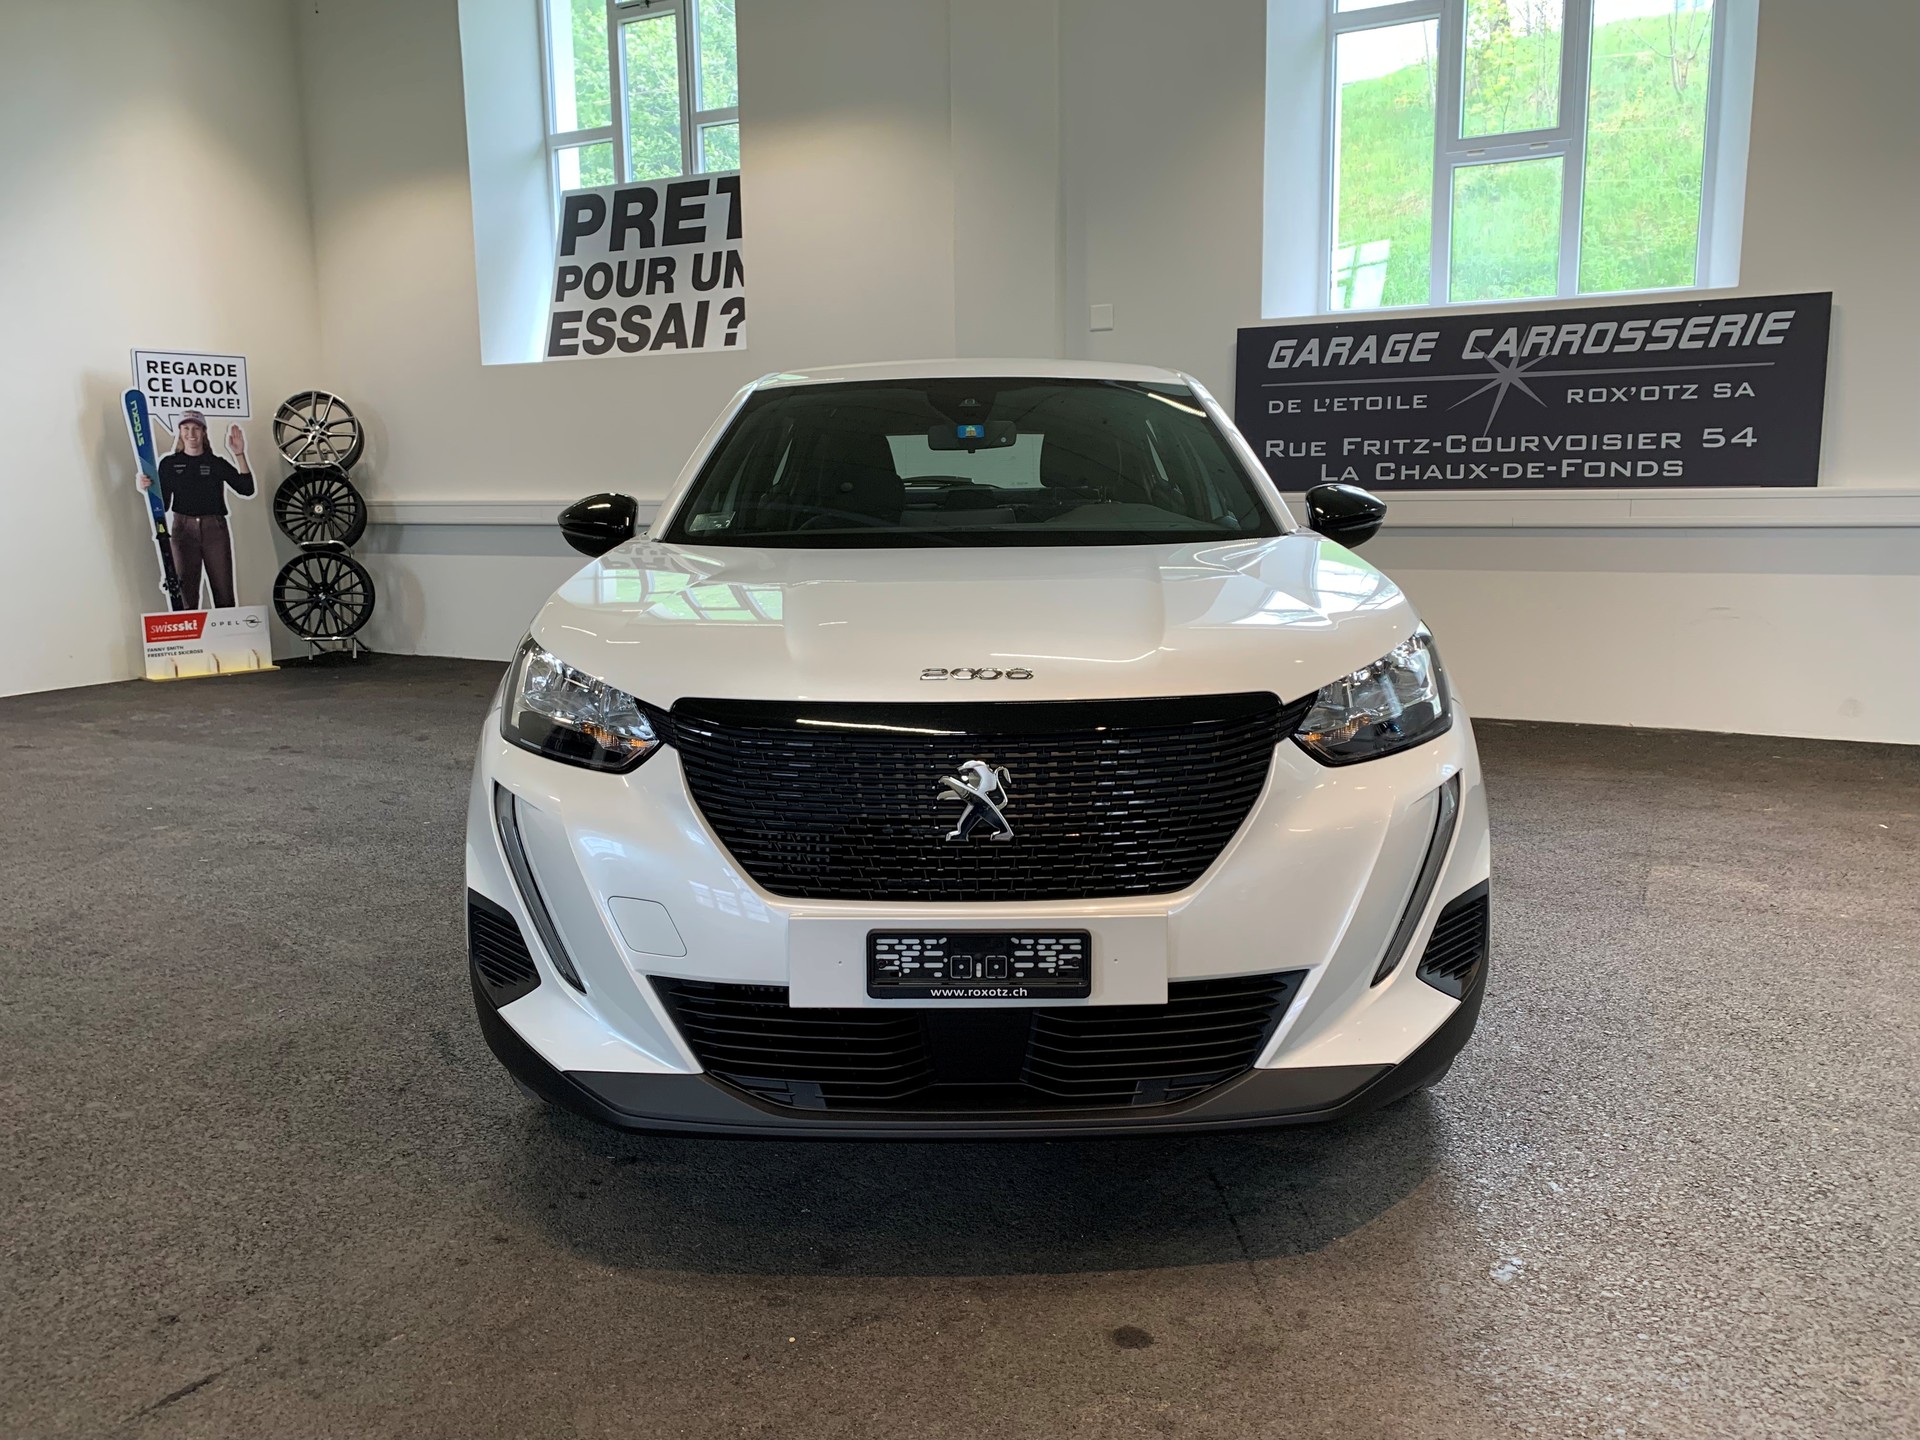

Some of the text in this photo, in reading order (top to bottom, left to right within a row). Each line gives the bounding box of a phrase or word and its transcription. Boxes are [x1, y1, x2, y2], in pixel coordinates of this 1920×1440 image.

[560, 175, 742, 256] PRET
[555, 256, 676, 302] POUR
[1267, 310, 1796, 369] GARAGE CARROSSERIE
[146, 360, 237, 377] REGARDE
[147, 377, 238, 395] CE LOOK
[1566, 381, 1756, 404] ROX'OTZ SA
[149, 395, 240, 409] TENDANCE!
[1268, 394, 1428, 414] DE L'ETOILE
[1702, 426, 1758, 448] 54
[919, 667, 1034, 681] 2008
[930, 987, 1028, 997] www.roxotz.ch
